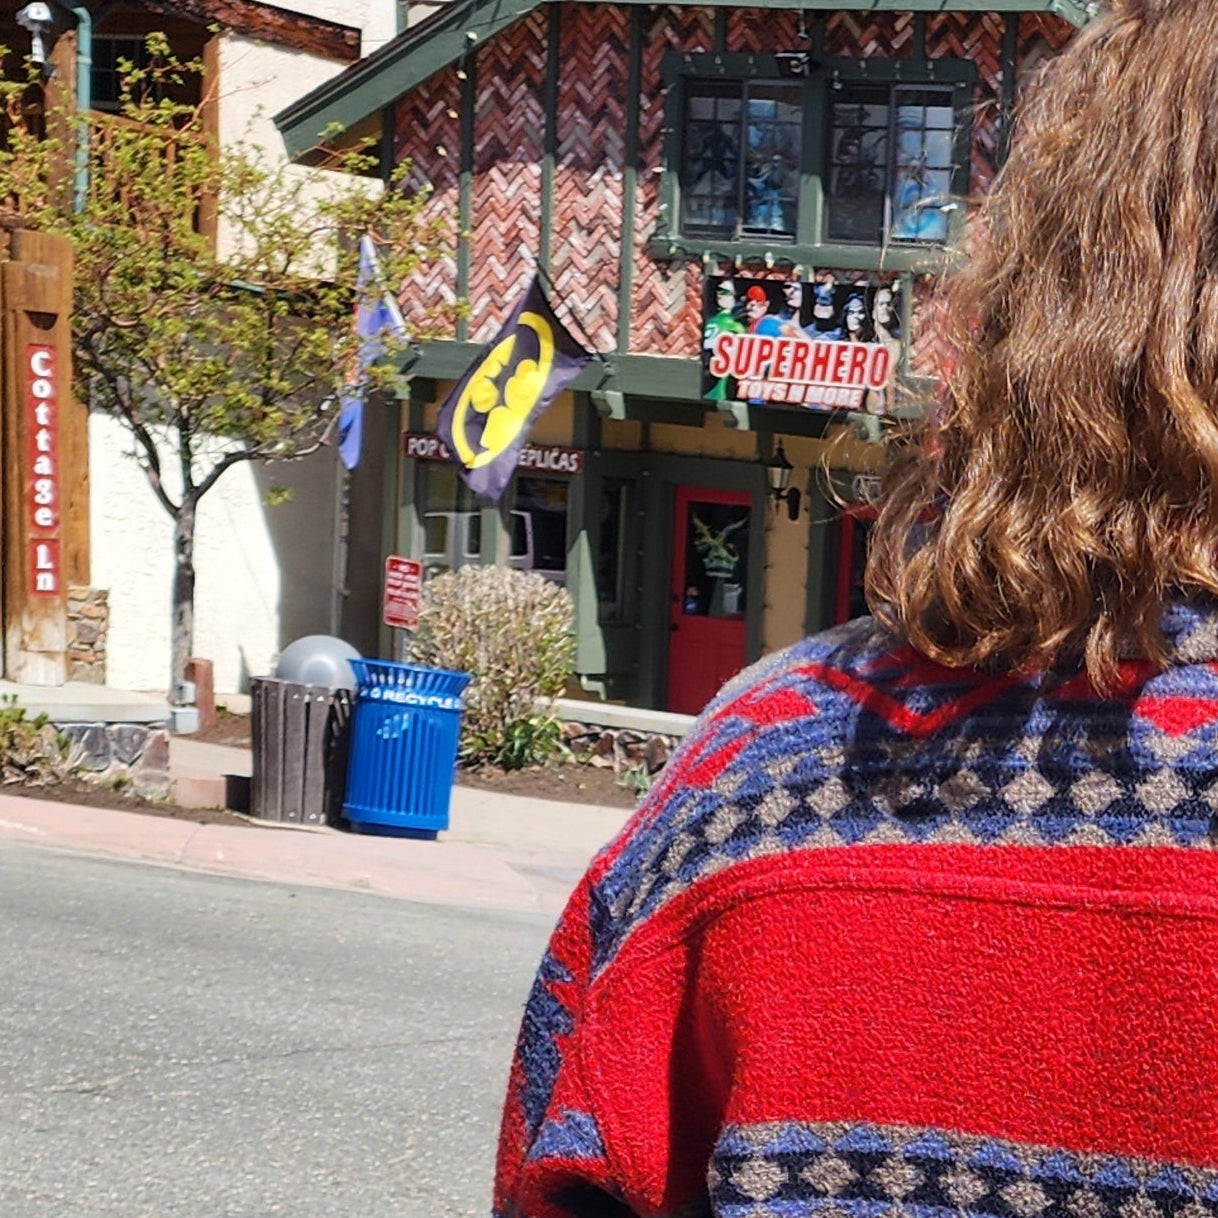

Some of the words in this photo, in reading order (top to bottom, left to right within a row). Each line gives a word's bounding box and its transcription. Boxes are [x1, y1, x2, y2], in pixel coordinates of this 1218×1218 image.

[711, 334, 891, 389] SUPERHERO
[736, 380, 788, 402] TOYS
[803, 385, 863, 410] MORE
[30, 350, 54, 526] Cottage
[407, 437, 437, 456] POP
[518, 448, 579, 473] EPLICAS
